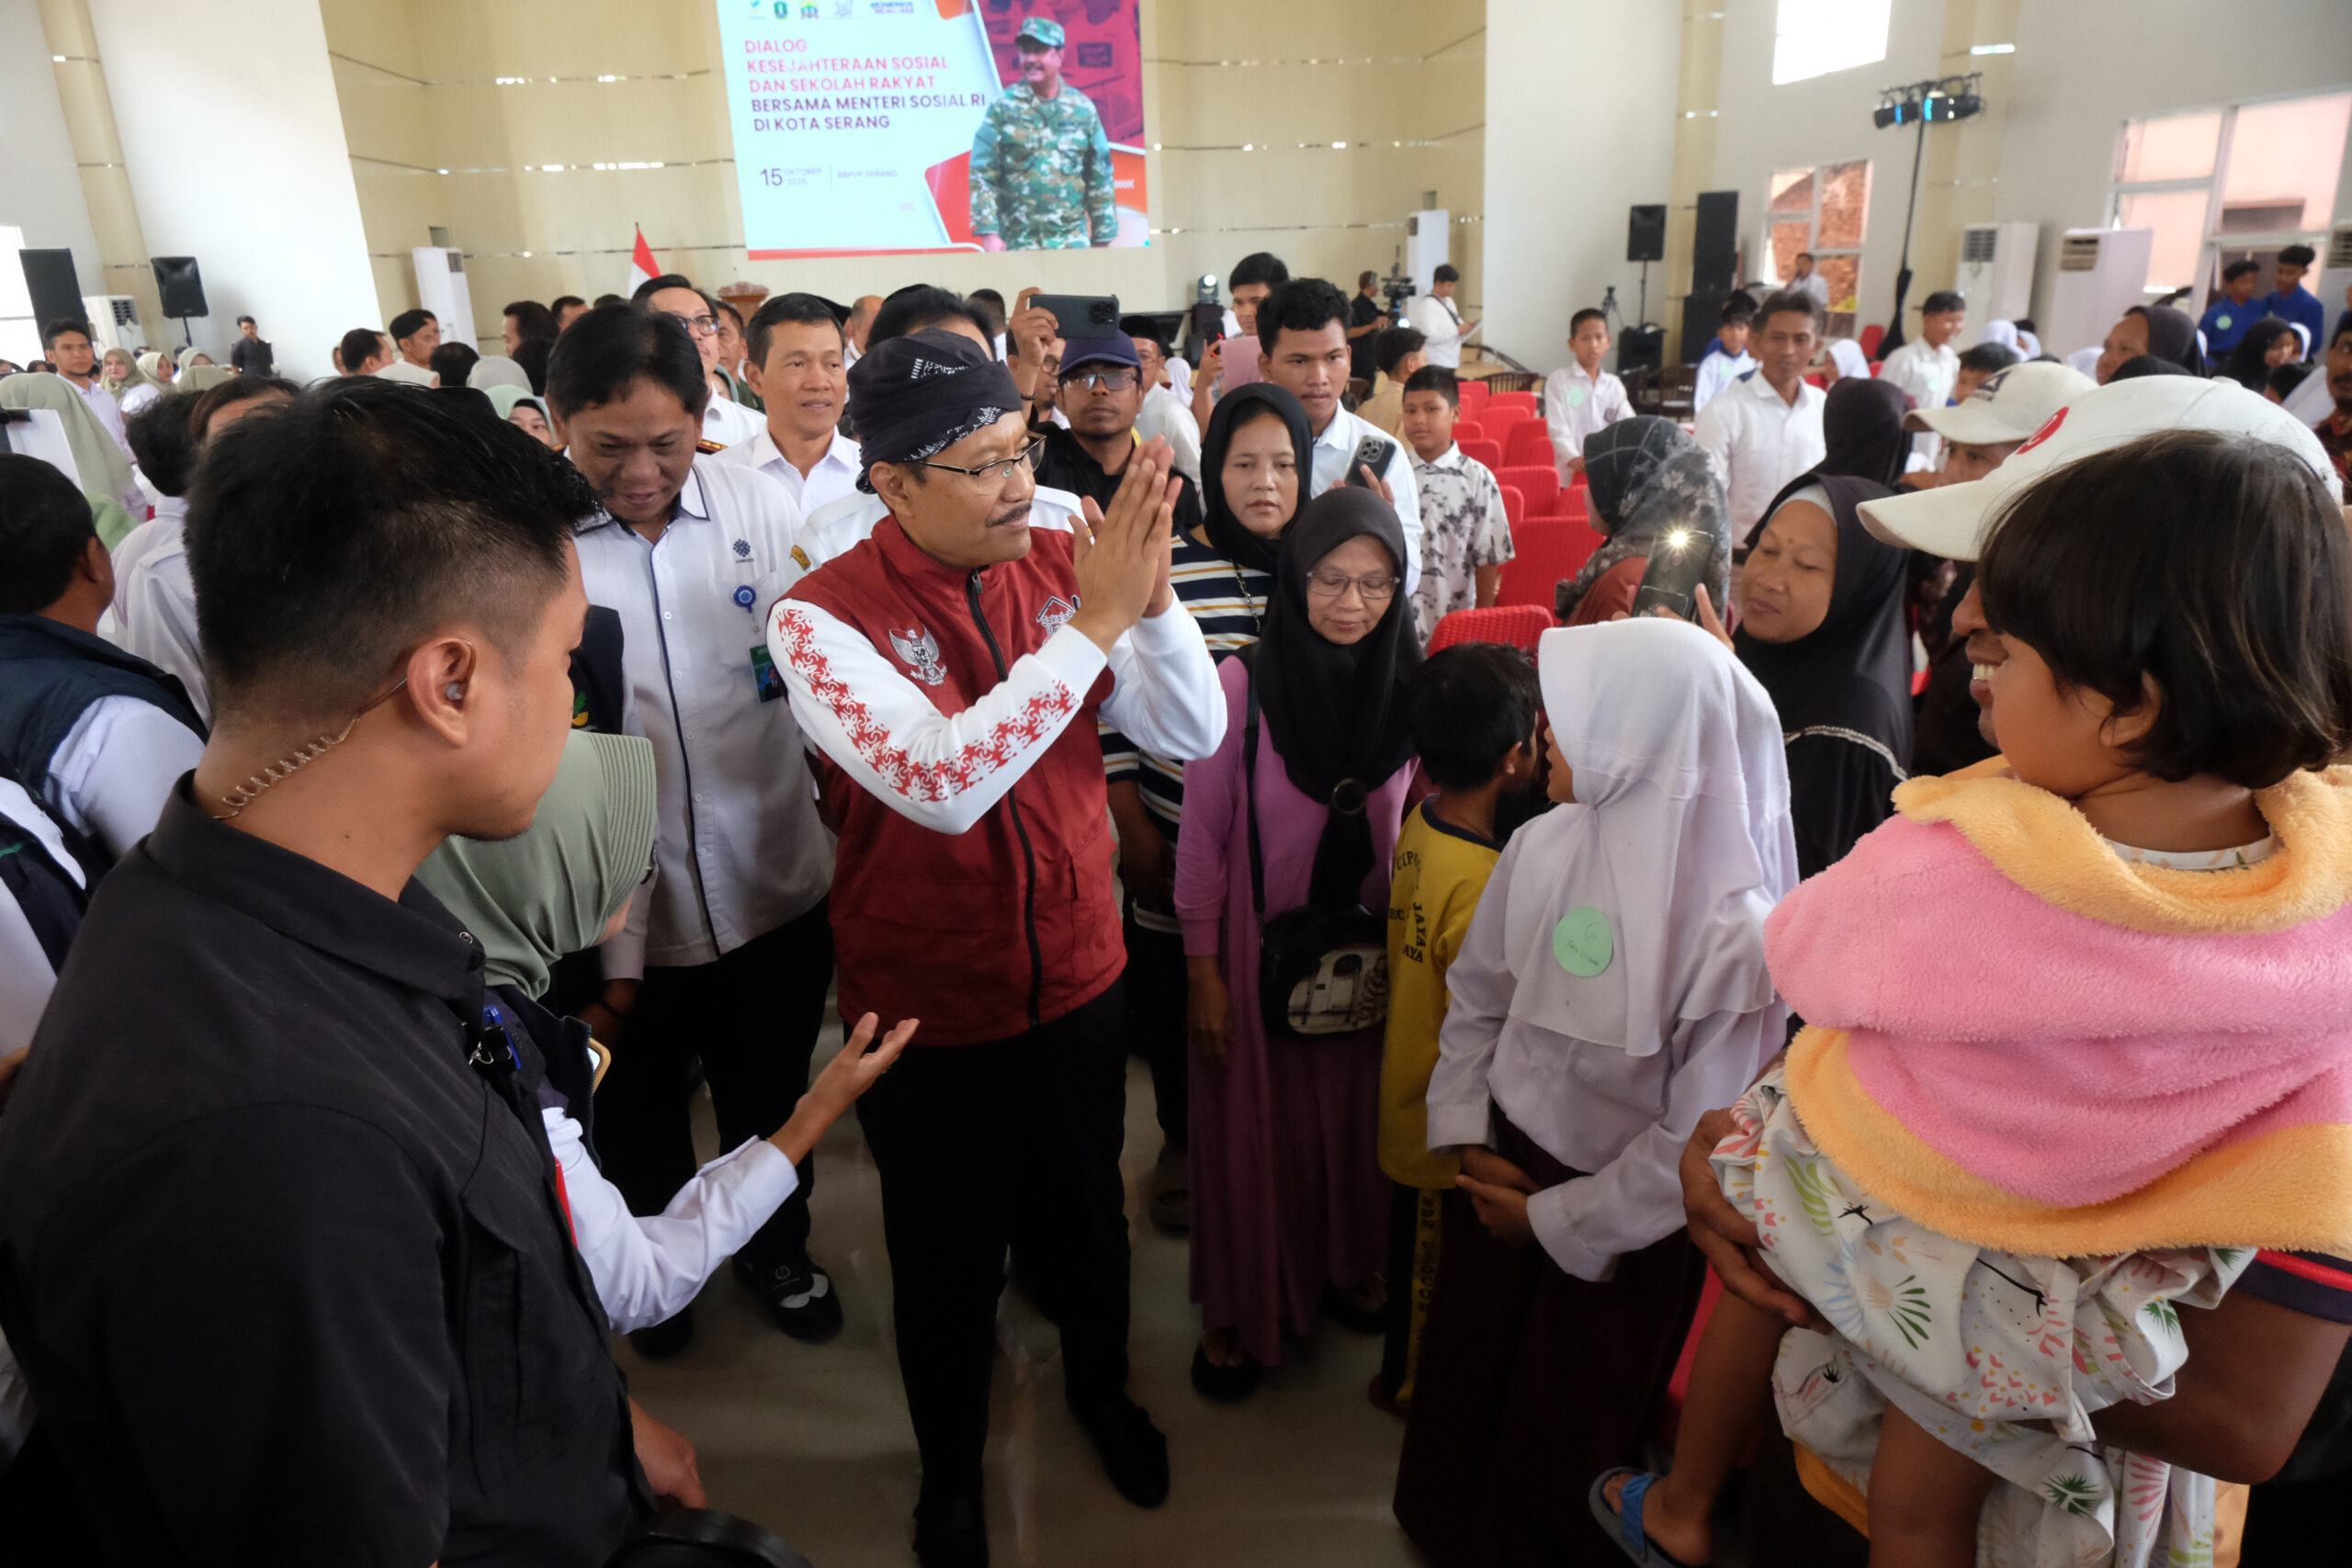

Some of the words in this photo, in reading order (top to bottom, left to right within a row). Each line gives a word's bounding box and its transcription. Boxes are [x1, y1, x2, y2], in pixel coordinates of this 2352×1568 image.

[745, 39, 808, 53] DIALOG
[747, 57, 887, 73] KESEJAHTERAAN
[891, 56, 948, 70] SOSIAL
[750, 79, 786, 93] DAN
[790, 77, 865, 92] SEKOLAH
[869, 75, 935, 89] RAKYAT
[752, 97, 831, 112] BERSAMA
[836, 96, 905, 109] MENTERI
[910, 94, 967, 108] SOSIAL
[970, 93, 986, 107] RI
[753, 118, 771, 131] DI
[775, 117, 820, 130] KOTA
[824, 115, 890, 130] SERANG
[760, 167, 783, 186] 15
[784, 167, 822, 176] OKTOBER
[865, 169, 898, 177] SERANG
